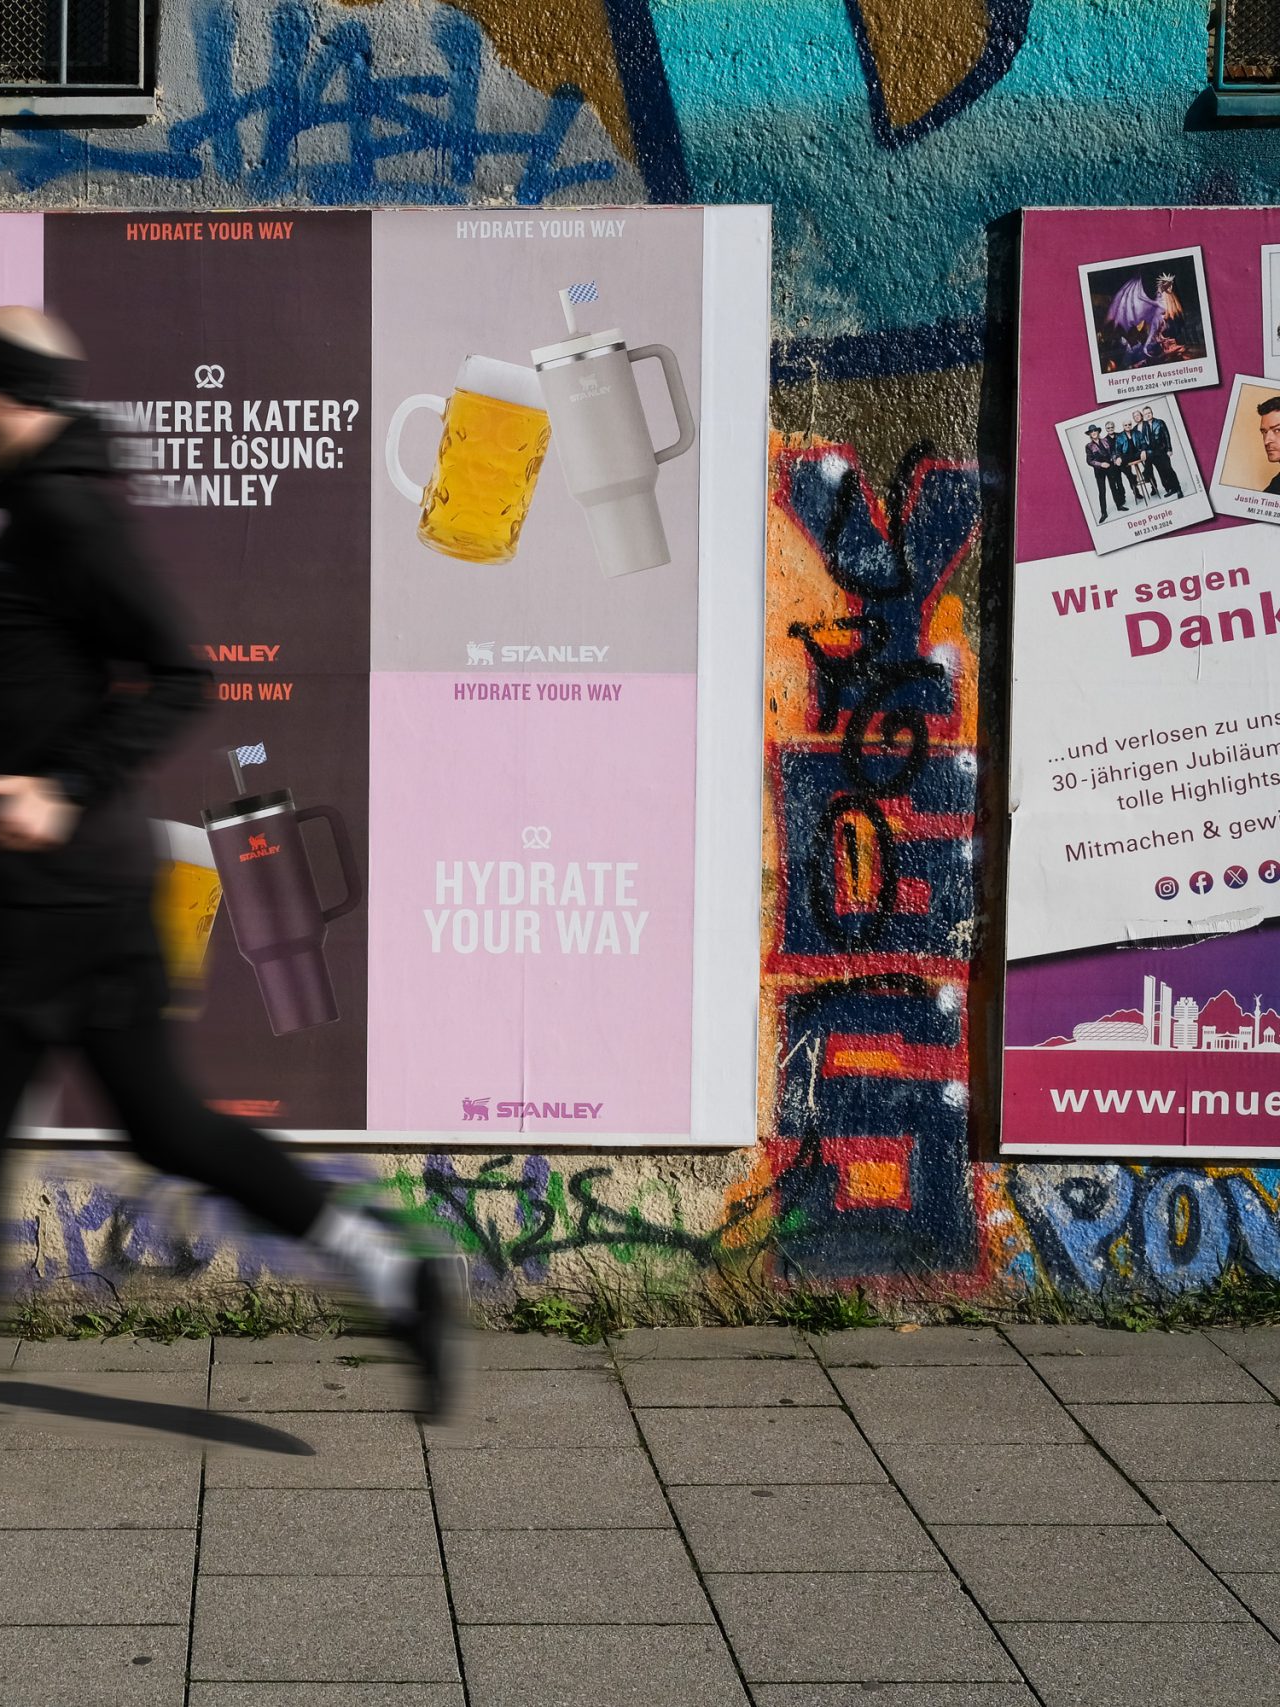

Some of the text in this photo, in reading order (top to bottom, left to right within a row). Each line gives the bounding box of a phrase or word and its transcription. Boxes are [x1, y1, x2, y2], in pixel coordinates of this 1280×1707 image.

[126, 221, 294, 242] HYDRATE YOUR WAY
[456, 219, 626, 239] HYDRATE YOUR WAY
[1108, 365, 1204, 387] Harry Potter Ausstellung
[100, 399, 360, 433] WERER KATER?
[110, 434, 345, 470] HTE LÖSUNG:
[1235, 494, 1280, 508] Justin Timb
[1127, 509, 1173, 529] Deep Purple
[1051, 566, 1250, 617] Wir sagen
[194, 644, 280, 662] ANLEY
[500, 645, 610, 663] STANLEY
[205, 683, 293, 701] OUR WAY
[454, 683, 622, 702] HYDRATE YOUR WAY
[1115, 724, 1208, 751] verlosen
[1214, 719, 1238, 735] zu
[1117, 771, 1280, 810] tolle Highlights
[1065, 829, 1194, 863] Mitmachen
[1203, 820, 1221, 840] &
[434, 861, 639, 908] HYDRATE
[423, 909, 650, 956] YOUR WAY
[495, 1101, 604, 1120] STANLEY
